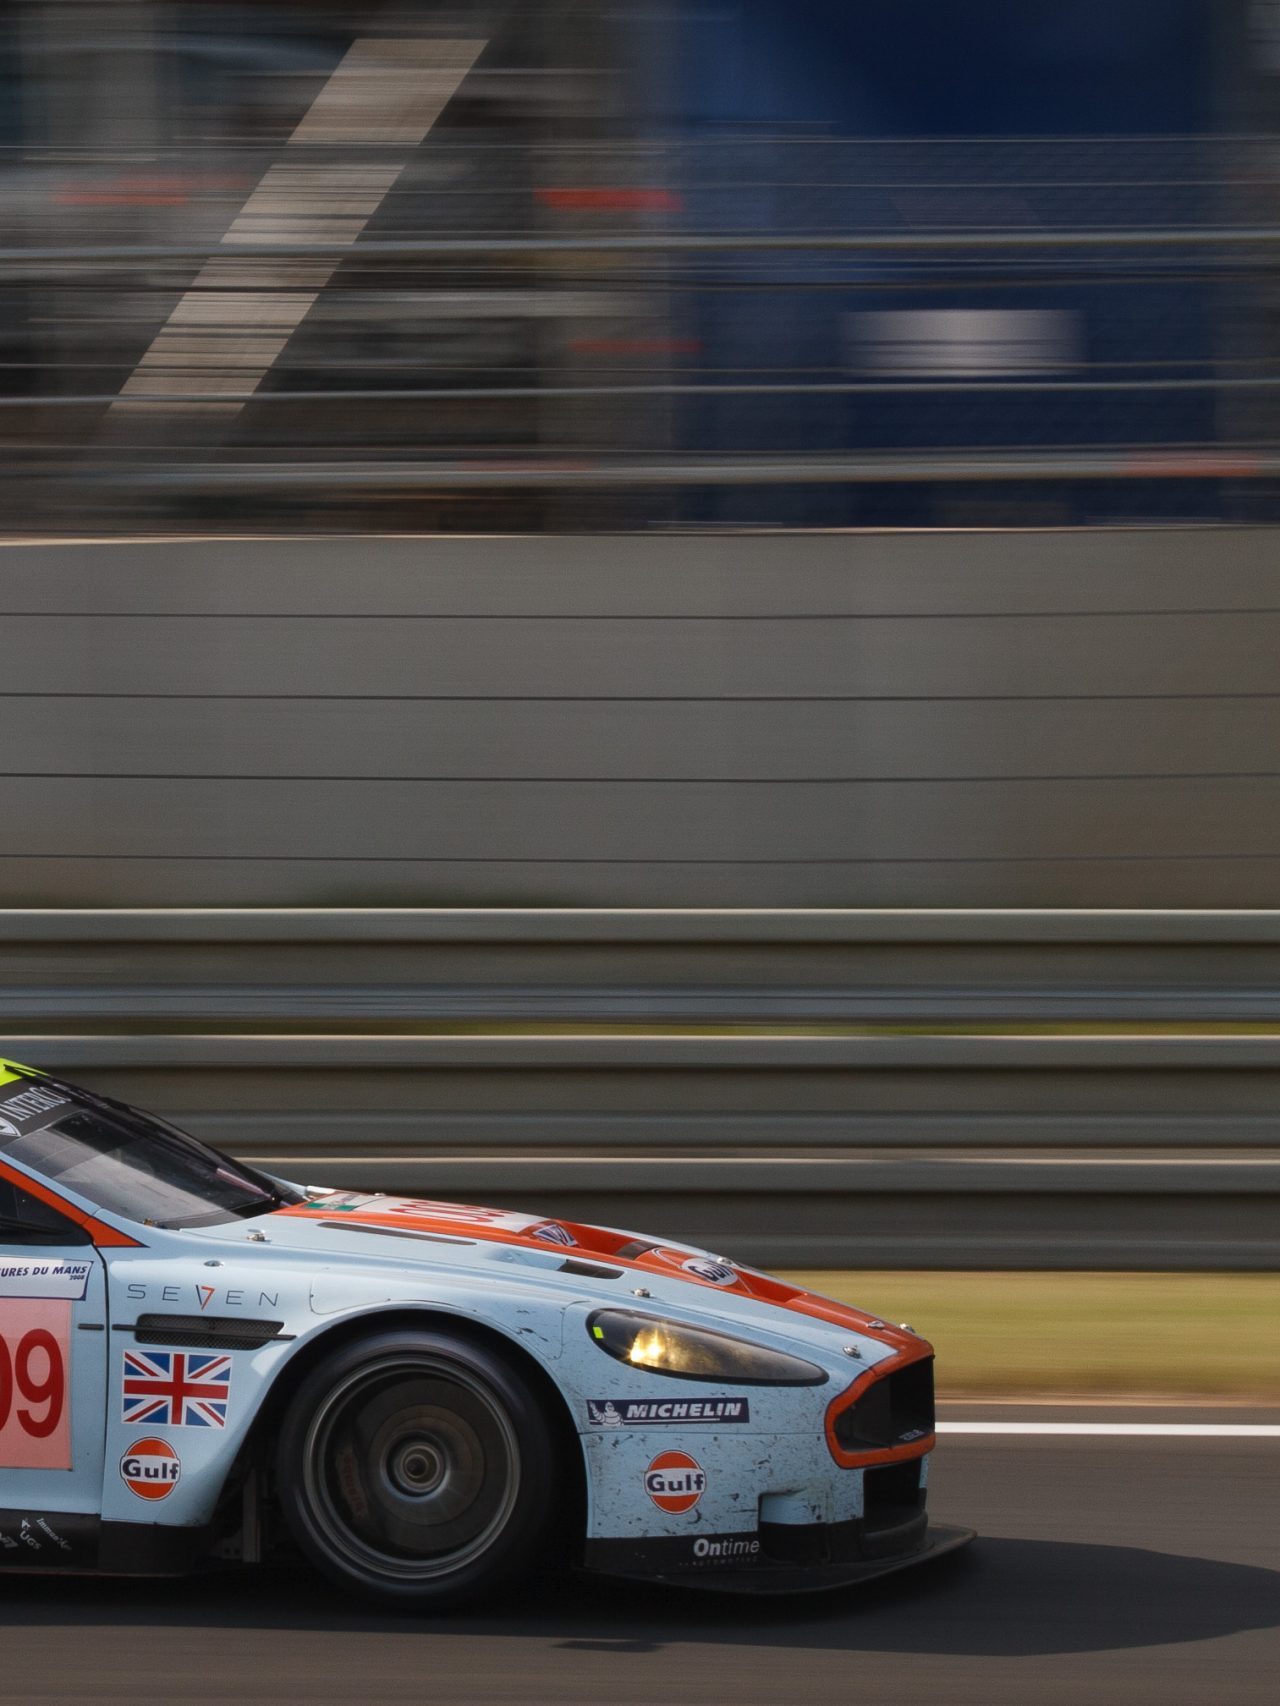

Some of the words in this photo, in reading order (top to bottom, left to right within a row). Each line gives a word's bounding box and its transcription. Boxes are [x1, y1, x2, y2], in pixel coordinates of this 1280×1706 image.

[31, 1266, 49, 1276] DU
[51, 1265, 88, 1275] MANS
[625, 1401, 743, 1420] MICHELIN
[121, 1457, 180, 1481] Gulf
[646, 1473, 705, 1493] Gulf
[693, 1537, 761, 1558] Ontime
